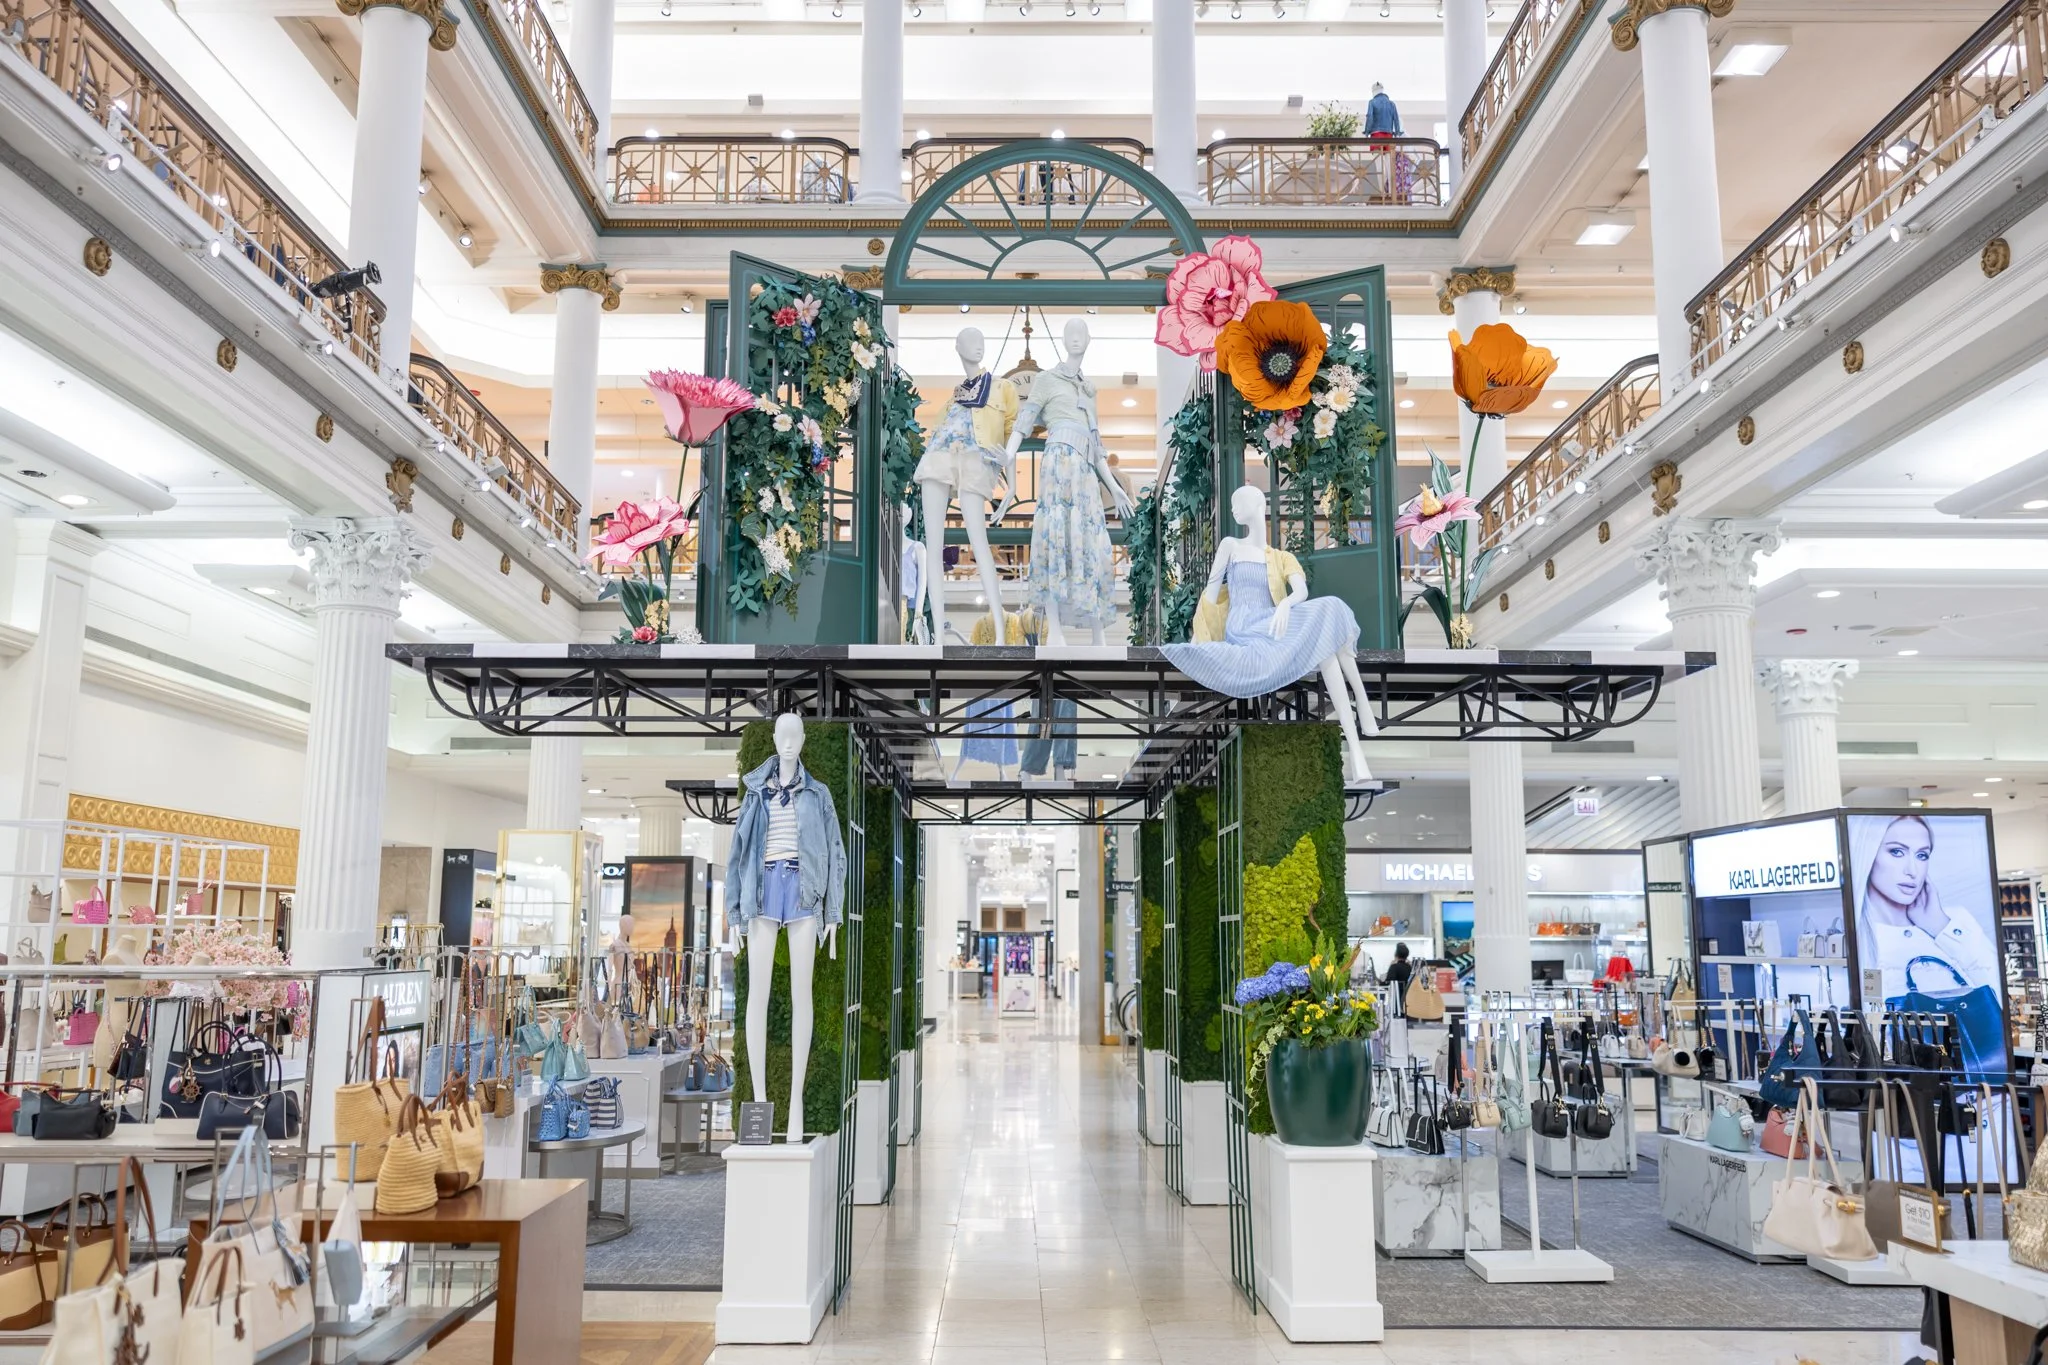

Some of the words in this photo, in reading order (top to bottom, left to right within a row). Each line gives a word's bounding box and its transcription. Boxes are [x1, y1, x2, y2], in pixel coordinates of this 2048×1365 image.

[1577, 799, 1595, 813] EXIT
[1385, 863, 1475, 881] MICHAEL
[1728, 869, 1760, 890] KARL
[1760, 861, 1836, 888] LAGERFELD
